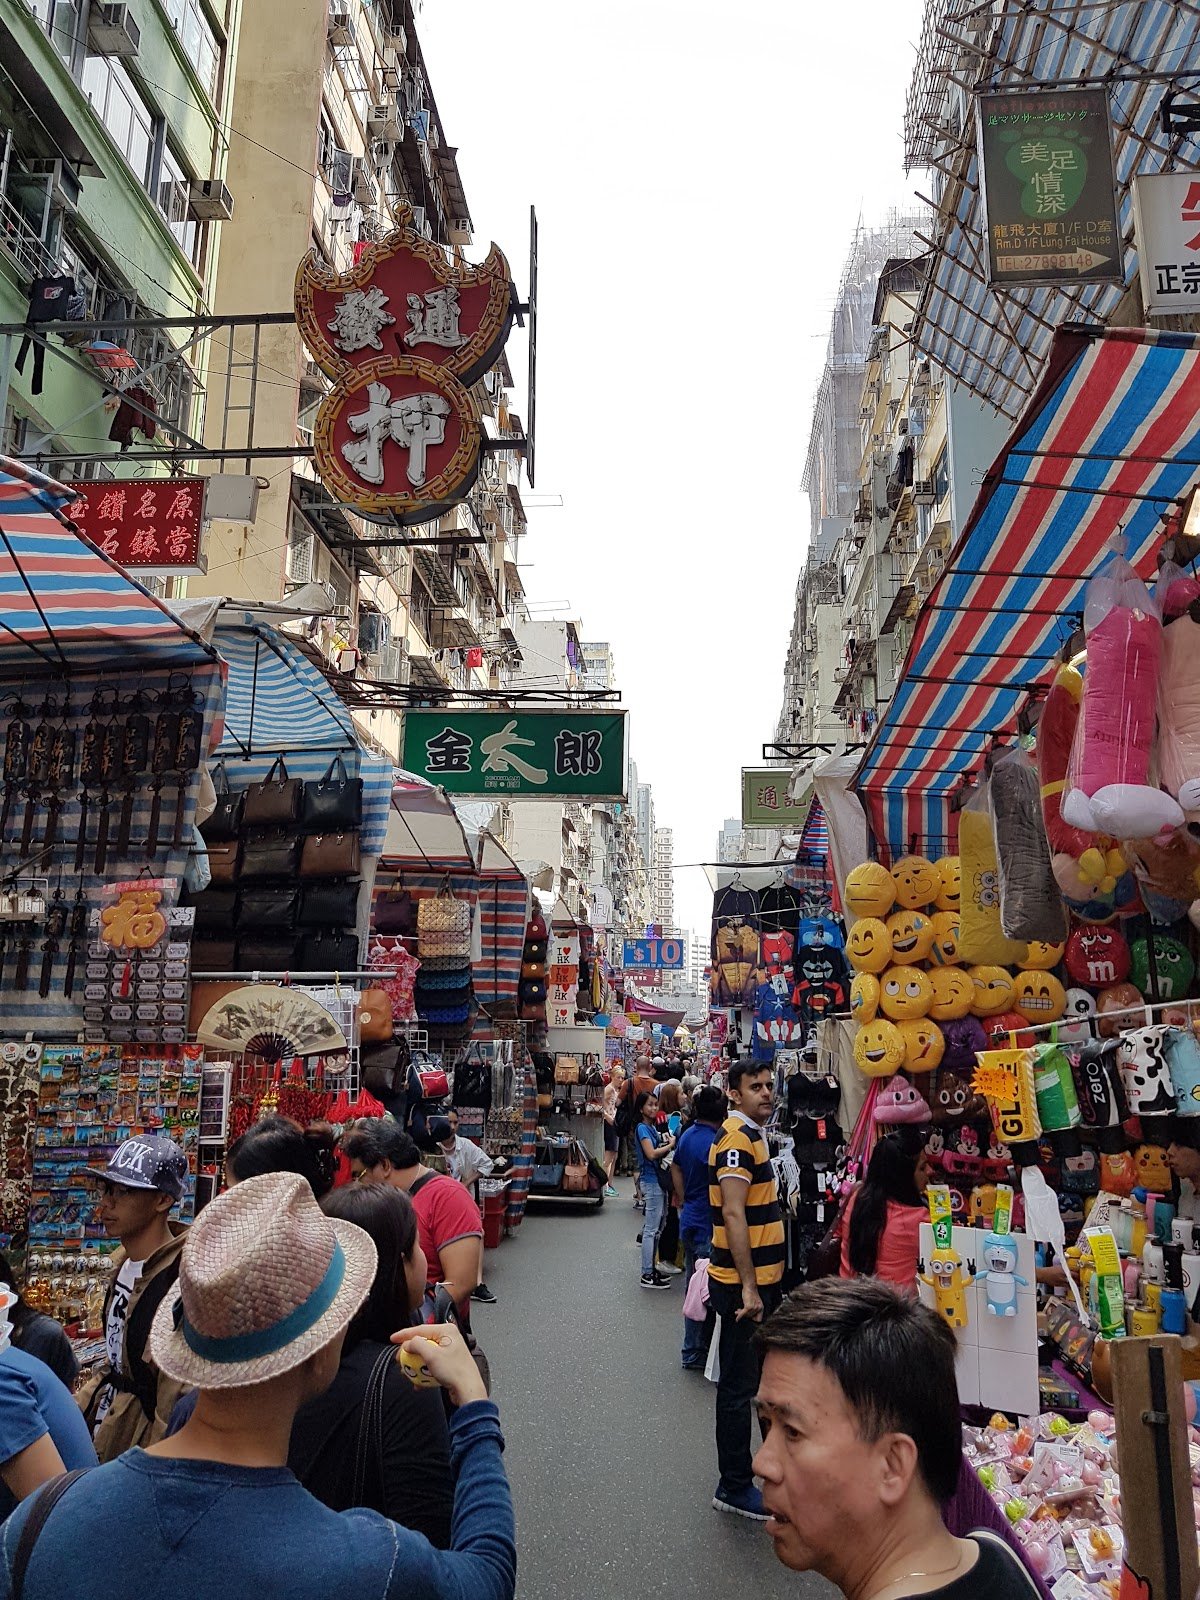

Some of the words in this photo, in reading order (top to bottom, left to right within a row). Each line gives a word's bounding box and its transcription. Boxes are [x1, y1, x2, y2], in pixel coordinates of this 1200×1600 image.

[1025, 237, 1038, 249] 1/F
[1040, 237, 1063, 249] Lung
[1065, 235, 1080, 246] Fai
[1081, 234, 1111, 246] House
[341, 381, 452, 486] 押
[425, 720, 603, 785] 金太郎
[757, 785, 812, 810] 通記
[557, 948, 562, 956] I
[557, 956, 570, 964] HK
[633, 939, 681, 964] $10
[556, 975, 568, 983] HK
[1087, 960, 1118, 982] m
[554, 992, 568, 1001] HK
[554, 1016, 568, 1025] HK
[1086, 1062, 1107, 1105] zero
[998, 1062, 1023, 1137] GLE
[727, 1149, 739, 1168] 8
